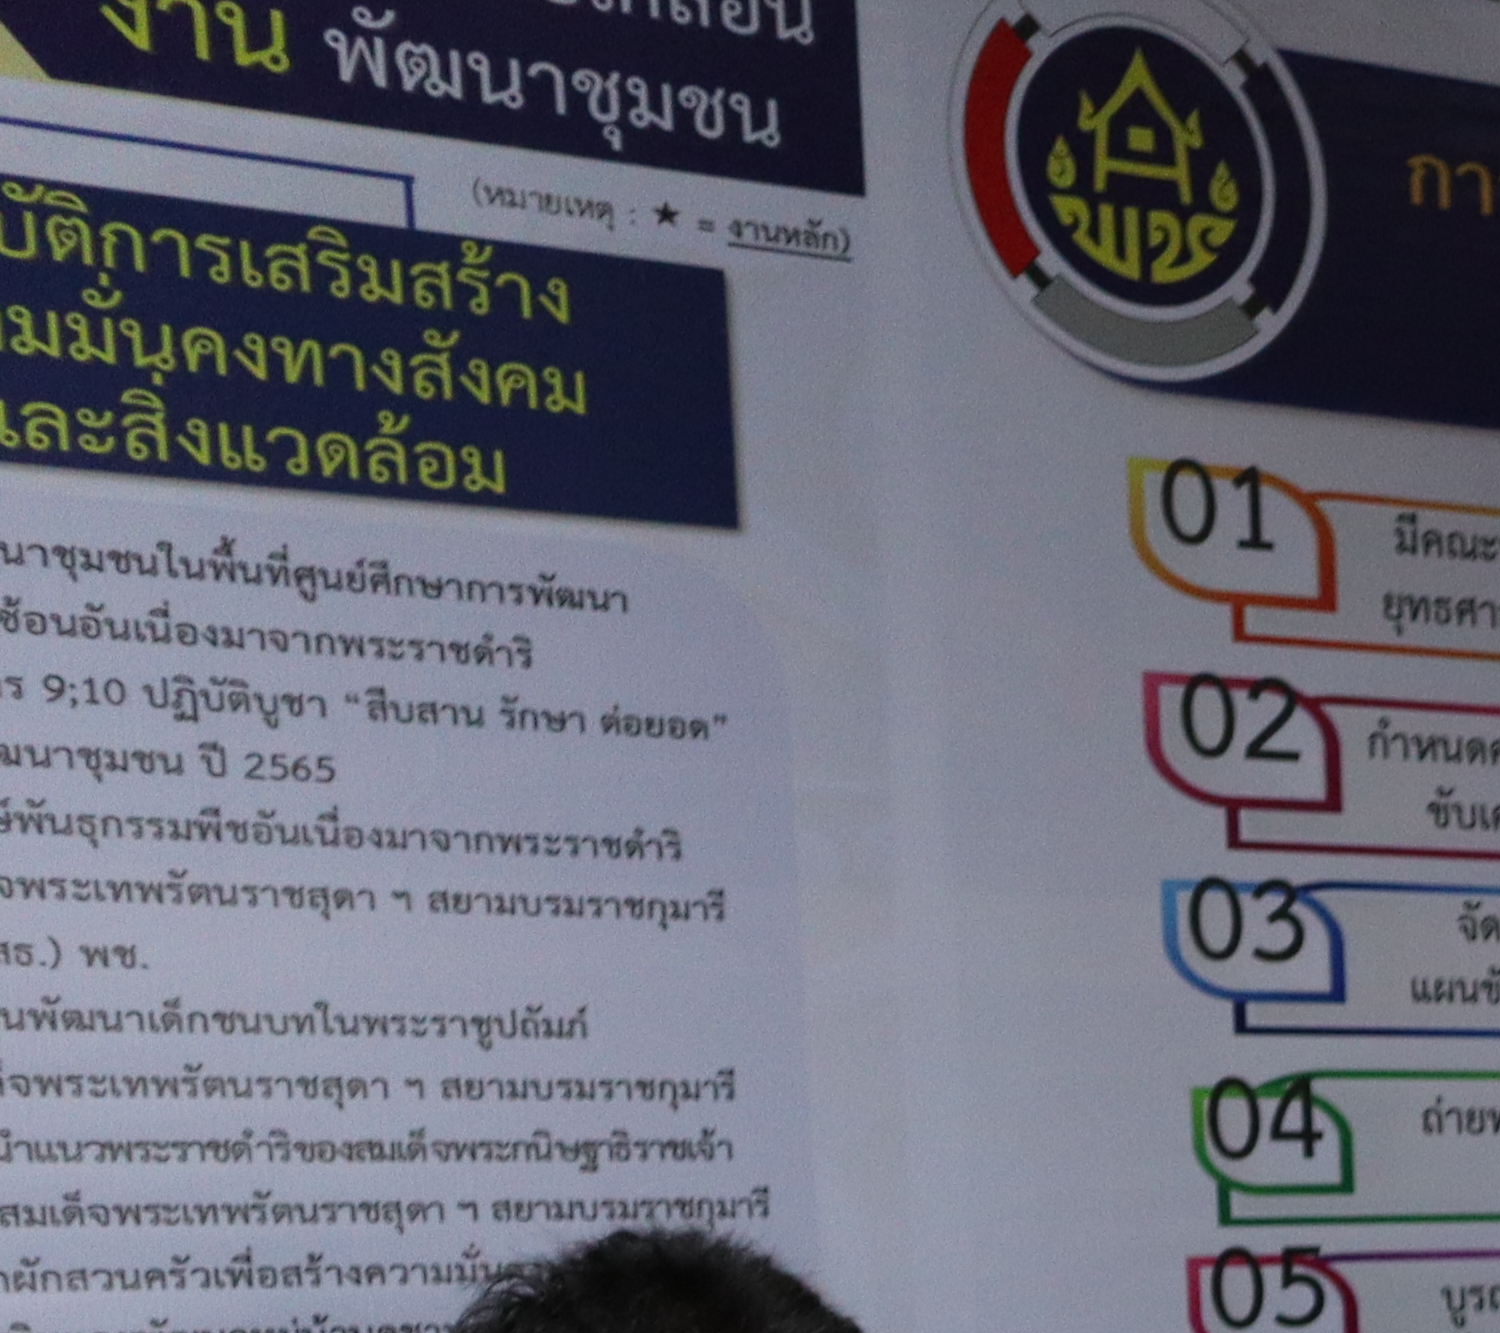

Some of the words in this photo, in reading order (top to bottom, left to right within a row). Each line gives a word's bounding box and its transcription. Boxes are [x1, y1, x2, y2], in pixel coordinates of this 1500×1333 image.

[323, 6, 782, 151] พัฒนาชุมชน
[0, 270, 587, 415] มมั่นคงทางสังคม
[1162, 461, 1274, 552] 01
[44, 674, 127, 711] 9;10
[144, 675, 328, 731] ปฏิบัติบูชา
[499, 697, 586, 736] รักษา
[1181, 673, 1300, 762] 02
[200, 740, 229, 778] ปี
[245, 752, 336, 785] 2565
[428, 885, 726, 926] สยามบรมราชกุมารี
[1190, 877, 1305, 963] 03
[0, 1062, 390, 1111] จพระเทพรัตนราชสุดา
[441, 1068, 736, 1113] สยามบรมราชกุมารี
[1207, 1076, 1323, 1160] 04
[0, 1245, 550, 1294] ผักสวนครัวเพื่อสร้างความมั่น
[1212, 1246, 1325, 1329] 05
